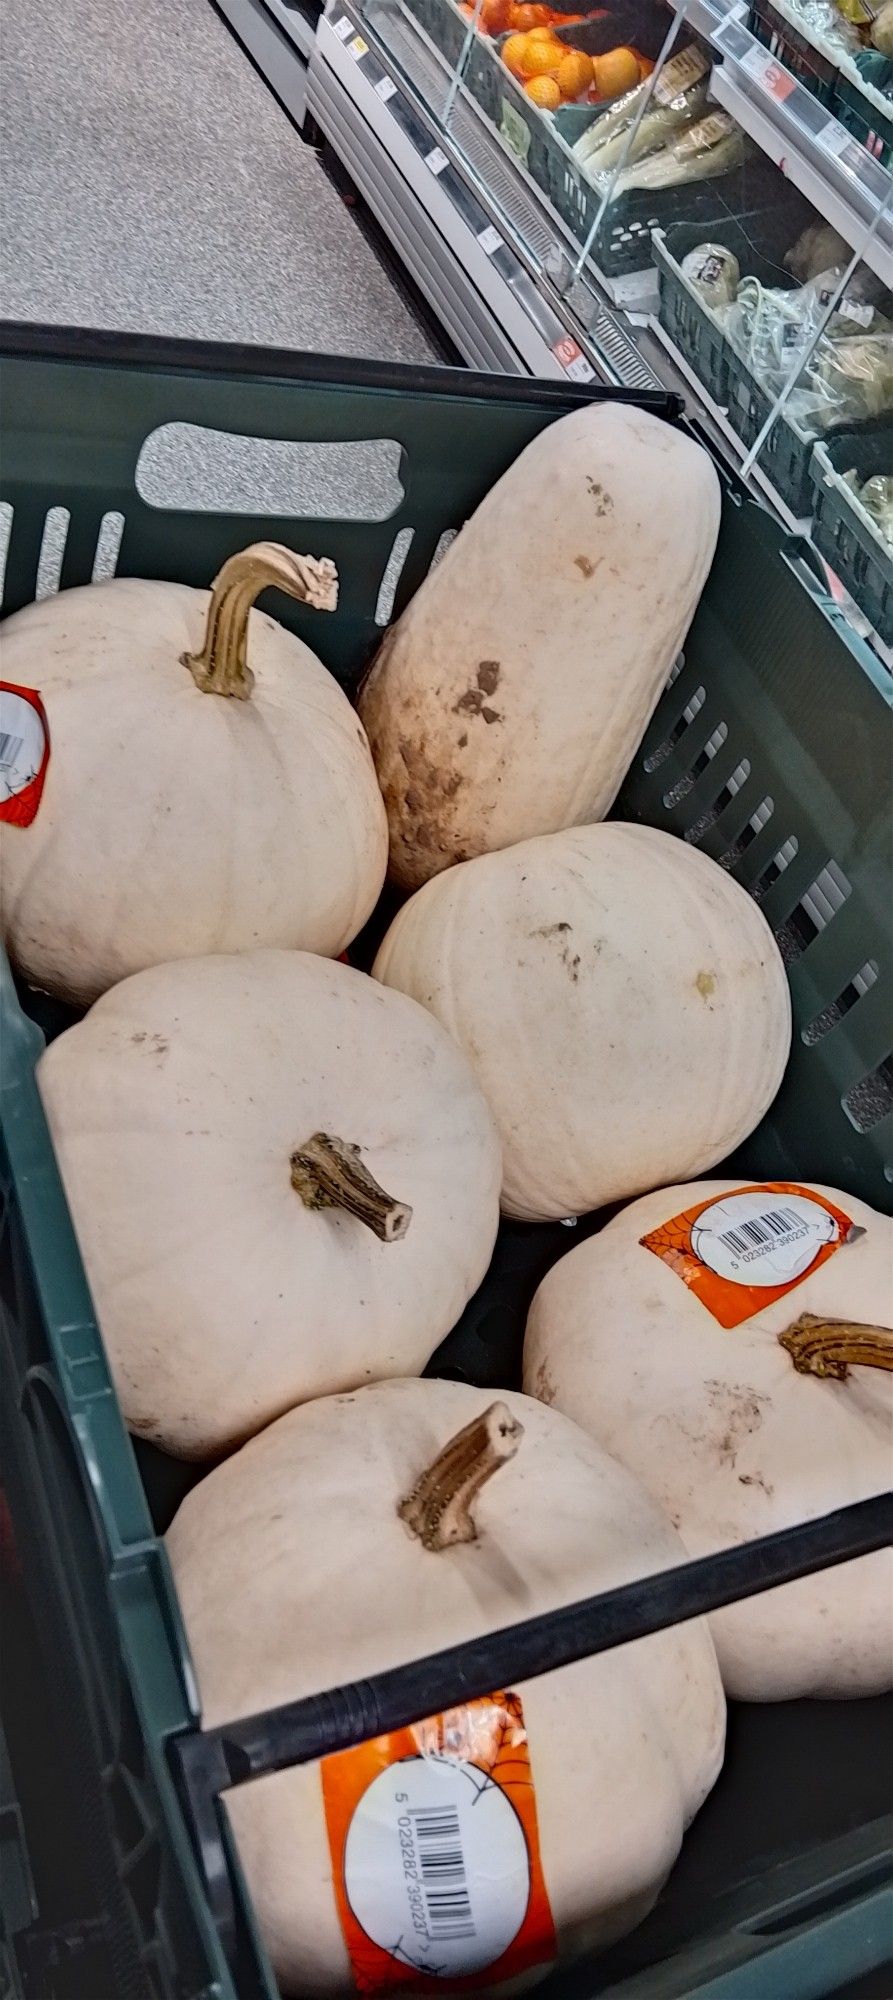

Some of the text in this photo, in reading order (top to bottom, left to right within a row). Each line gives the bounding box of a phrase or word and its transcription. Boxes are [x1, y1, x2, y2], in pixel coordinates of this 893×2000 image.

[730, 1261, 739, 1269] 5
[742, 1241, 777, 1263] 023282
[777, 1227, 810, 1247] 390237
[395, 1792, 409, 1803] 5
[397, 1816, 418, 1880] 023282
[407, 1885, 430, 1938] 390237
